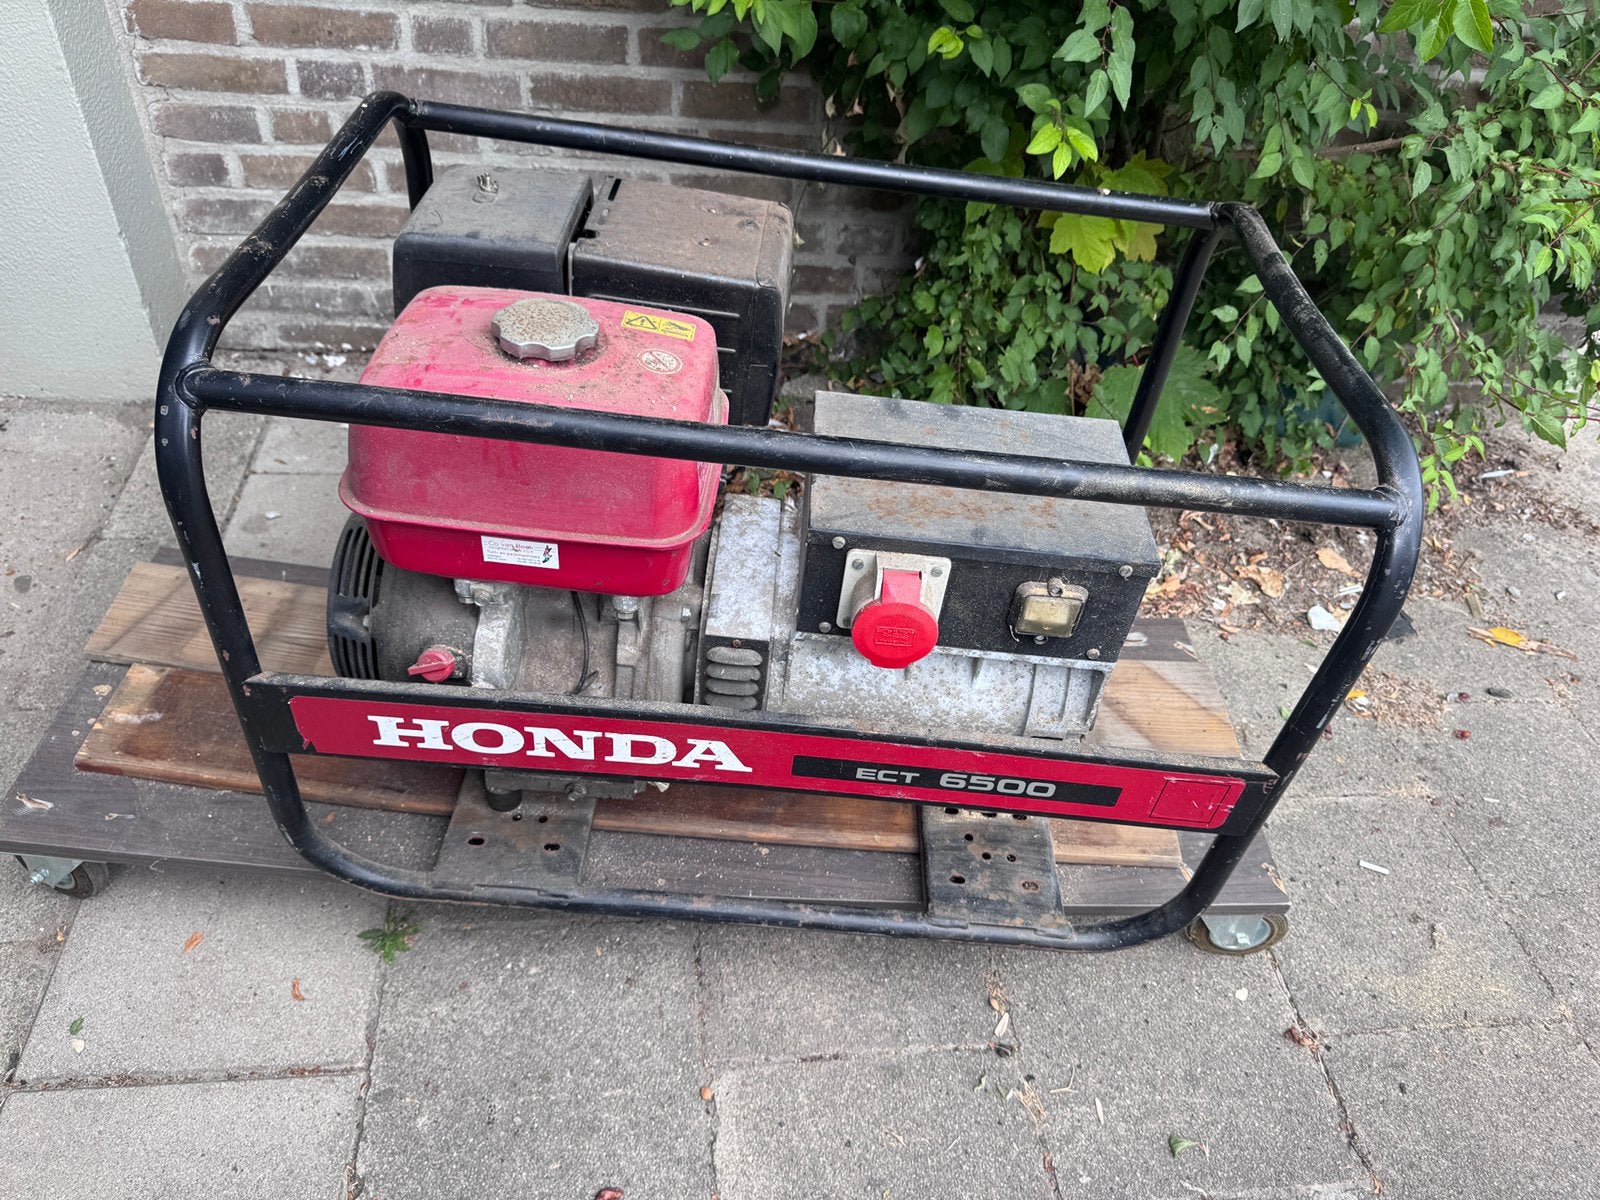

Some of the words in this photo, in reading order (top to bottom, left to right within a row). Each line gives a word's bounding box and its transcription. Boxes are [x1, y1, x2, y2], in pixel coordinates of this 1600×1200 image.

[367, 715, 753, 773] HONDA
[855, 767, 920, 784] ECT
[939, 773, 1057, 798] 6500
